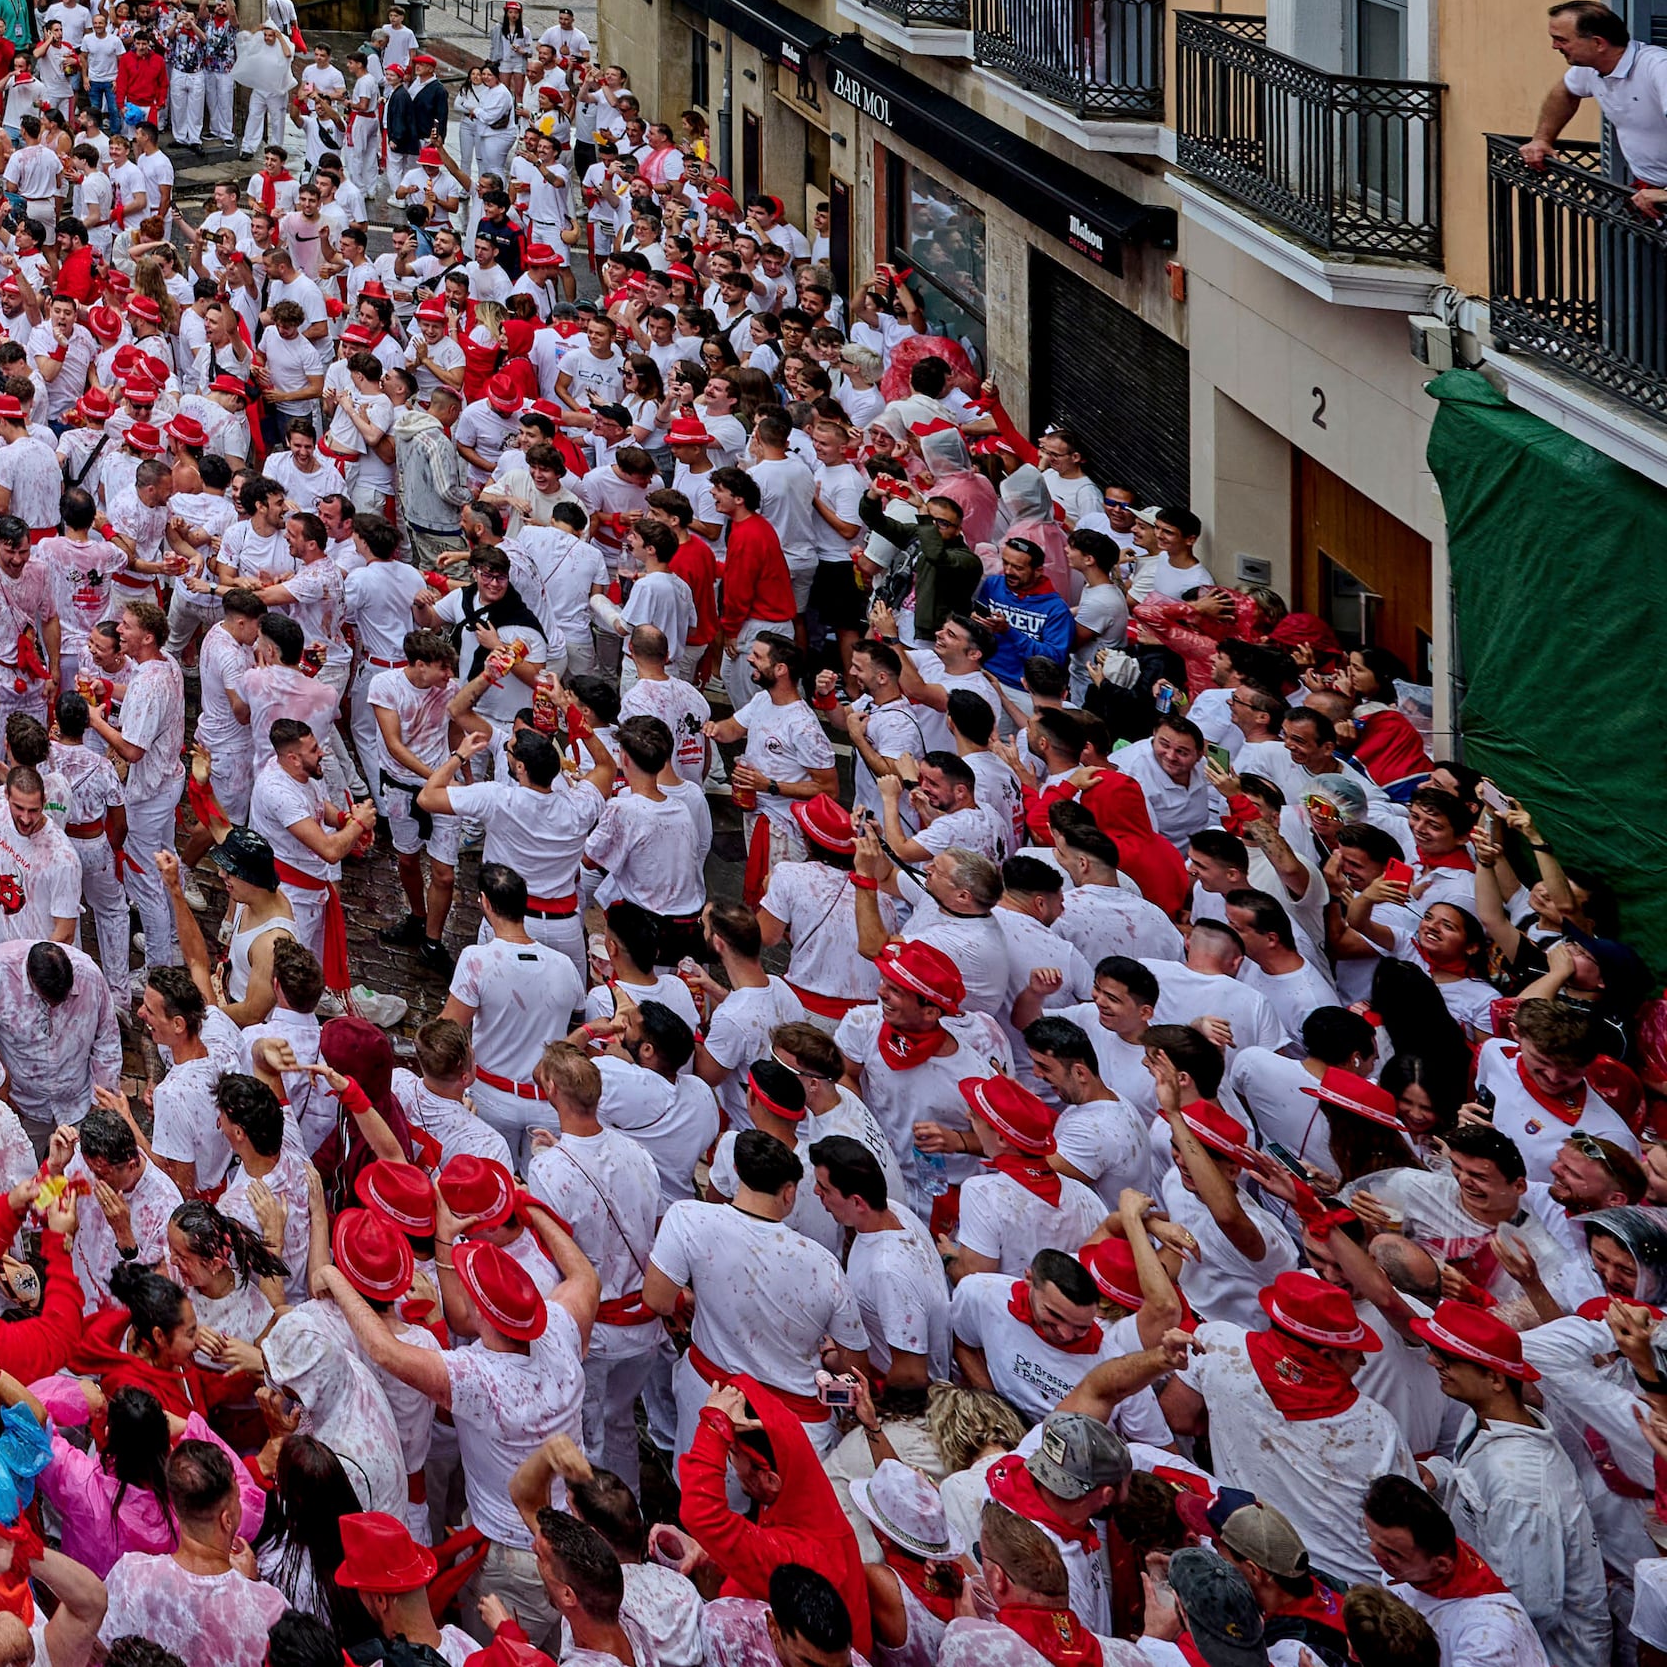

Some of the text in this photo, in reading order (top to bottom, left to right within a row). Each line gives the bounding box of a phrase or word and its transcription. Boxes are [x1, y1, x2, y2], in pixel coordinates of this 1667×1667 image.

[833, 69, 893, 127] BAR MOL
[1069, 214, 1103, 251] Mahou
[1311, 386, 1329, 430] 2
[1013, 1364, 1020, 1375] à
[1015, 1353, 1033, 1369] De
